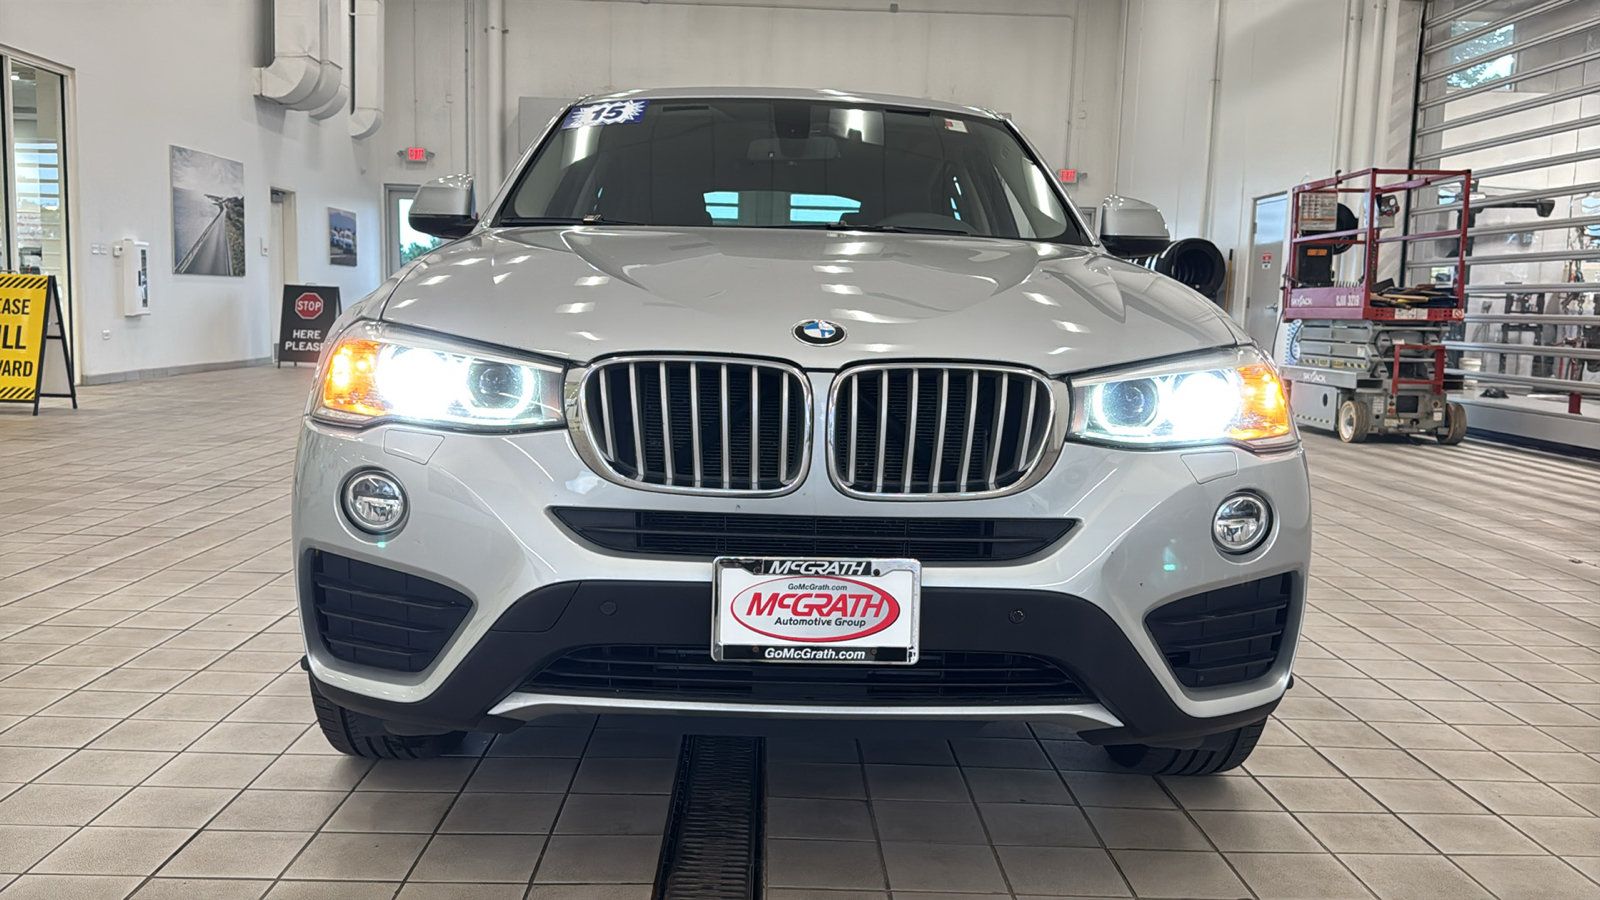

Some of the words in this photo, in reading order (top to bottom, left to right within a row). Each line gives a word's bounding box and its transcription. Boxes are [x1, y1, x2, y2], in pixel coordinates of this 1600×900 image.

[592, 105, 626, 121] 15
[0, 298, 31, 315] ASE
[297, 301, 321, 311] STOP
[0, 325, 27, 350] LL
[292, 329, 321, 339] HERE
[0, 360, 33, 377] ARD
[787, 583, 848, 591] GoMcGrath.com
[774, 616, 832, 627] Automotive
[834, 617, 866, 628] Group
[764, 647, 866, 660] GoMcGrath.com
